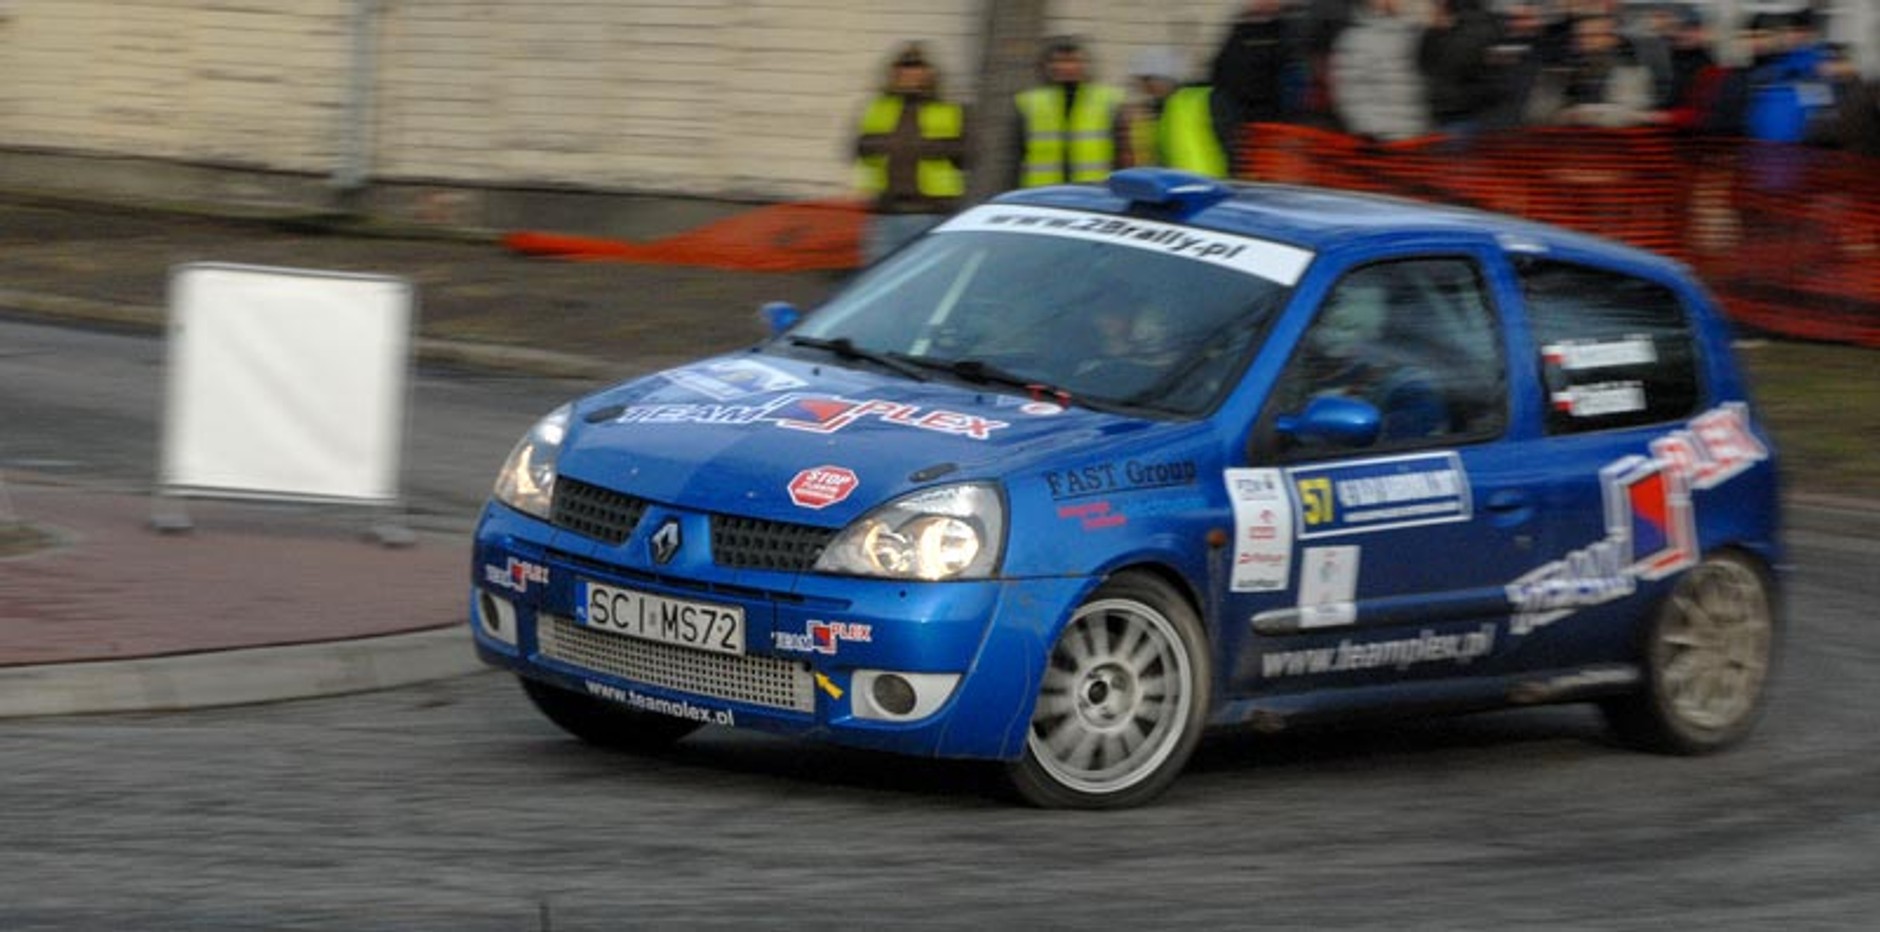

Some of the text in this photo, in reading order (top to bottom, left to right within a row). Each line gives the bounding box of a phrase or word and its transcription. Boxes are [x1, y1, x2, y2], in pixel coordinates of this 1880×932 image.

[615, 400, 1009, 440] TEAM PLEX
[806, 470, 853, 486] STOP
[1042, 458, 1197, 496] FAST Group
[1297, 477, 1334, 525] 57
[590, 588, 739, 651] SCI MS72
[829, 621, 872, 642] PLEX
